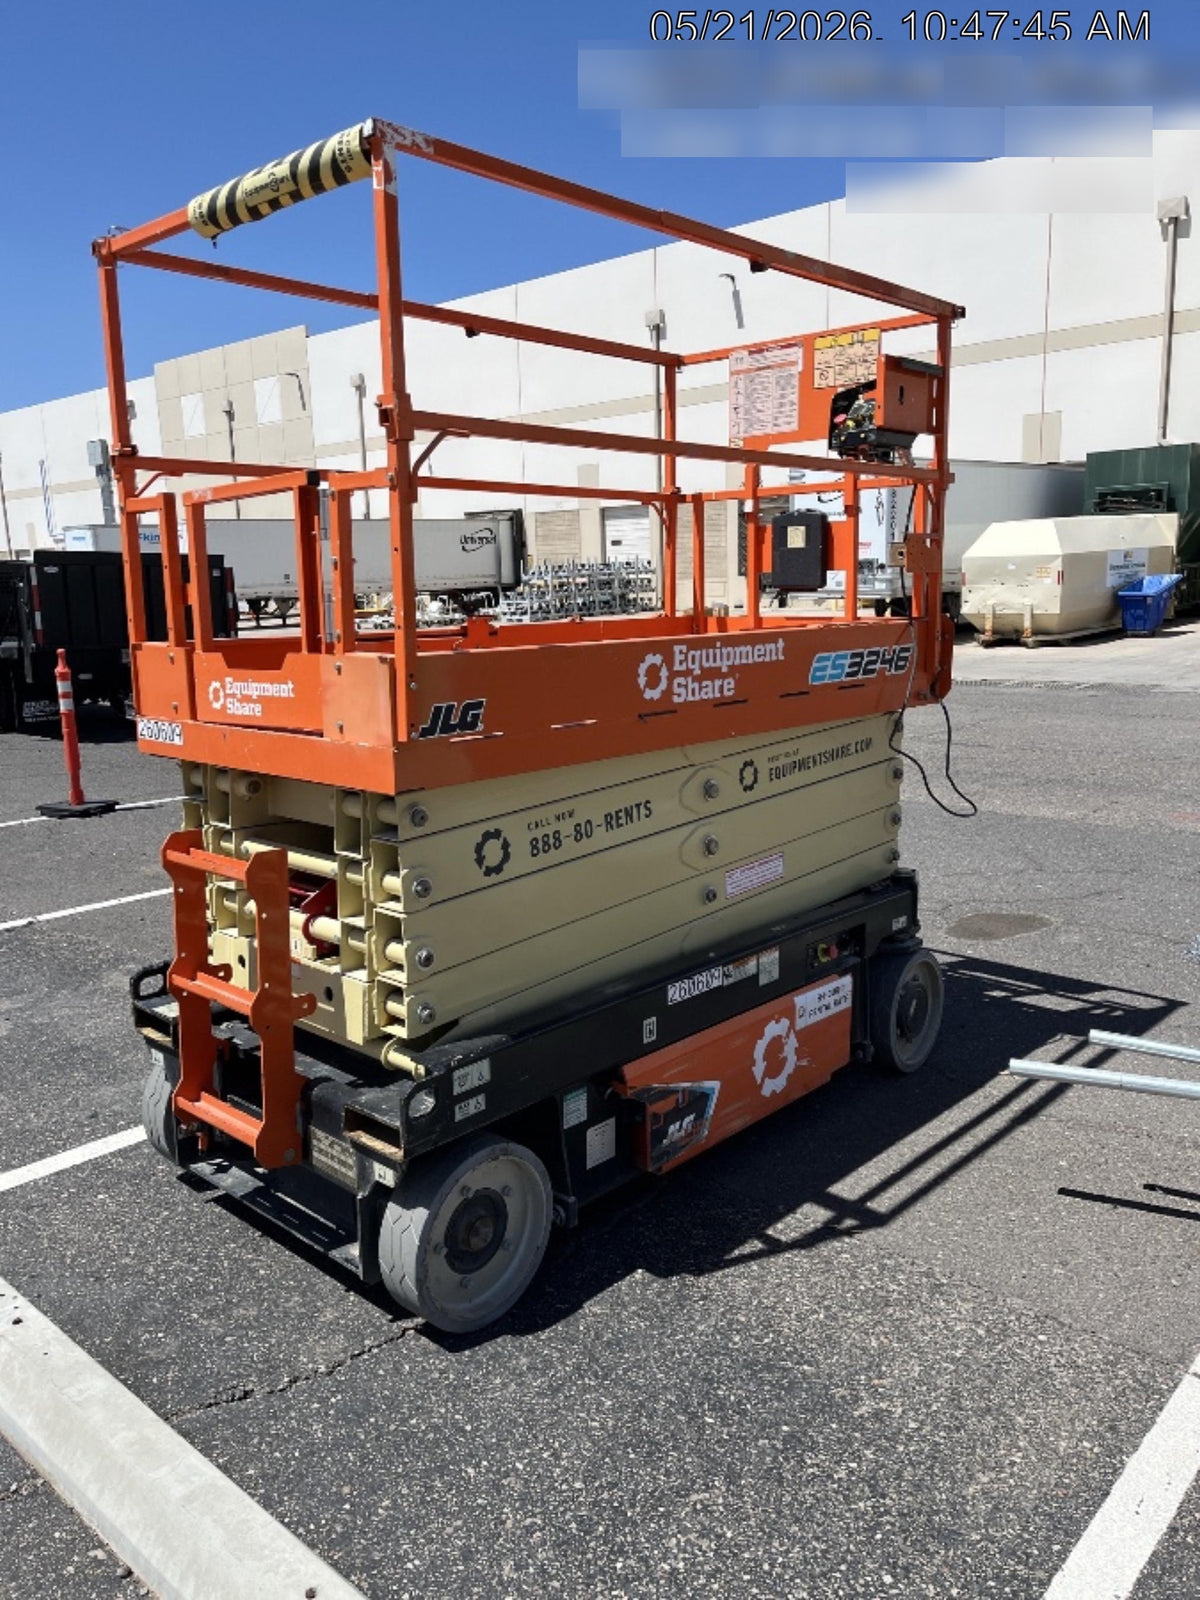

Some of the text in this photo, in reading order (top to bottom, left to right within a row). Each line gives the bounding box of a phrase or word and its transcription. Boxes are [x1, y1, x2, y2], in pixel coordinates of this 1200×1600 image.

[672, 638, 785, 676] Equipment
[809, 642, 915, 685] ES3246
[224, 676, 295, 699] Equipment
[672, 677, 736, 704] Share
[225, 698, 262, 717] Share
[417, 698, 486, 740] JLG
[526, 807, 576, 833] CALL NOW
[528, 798, 653, 858] 888-80-RENTS
